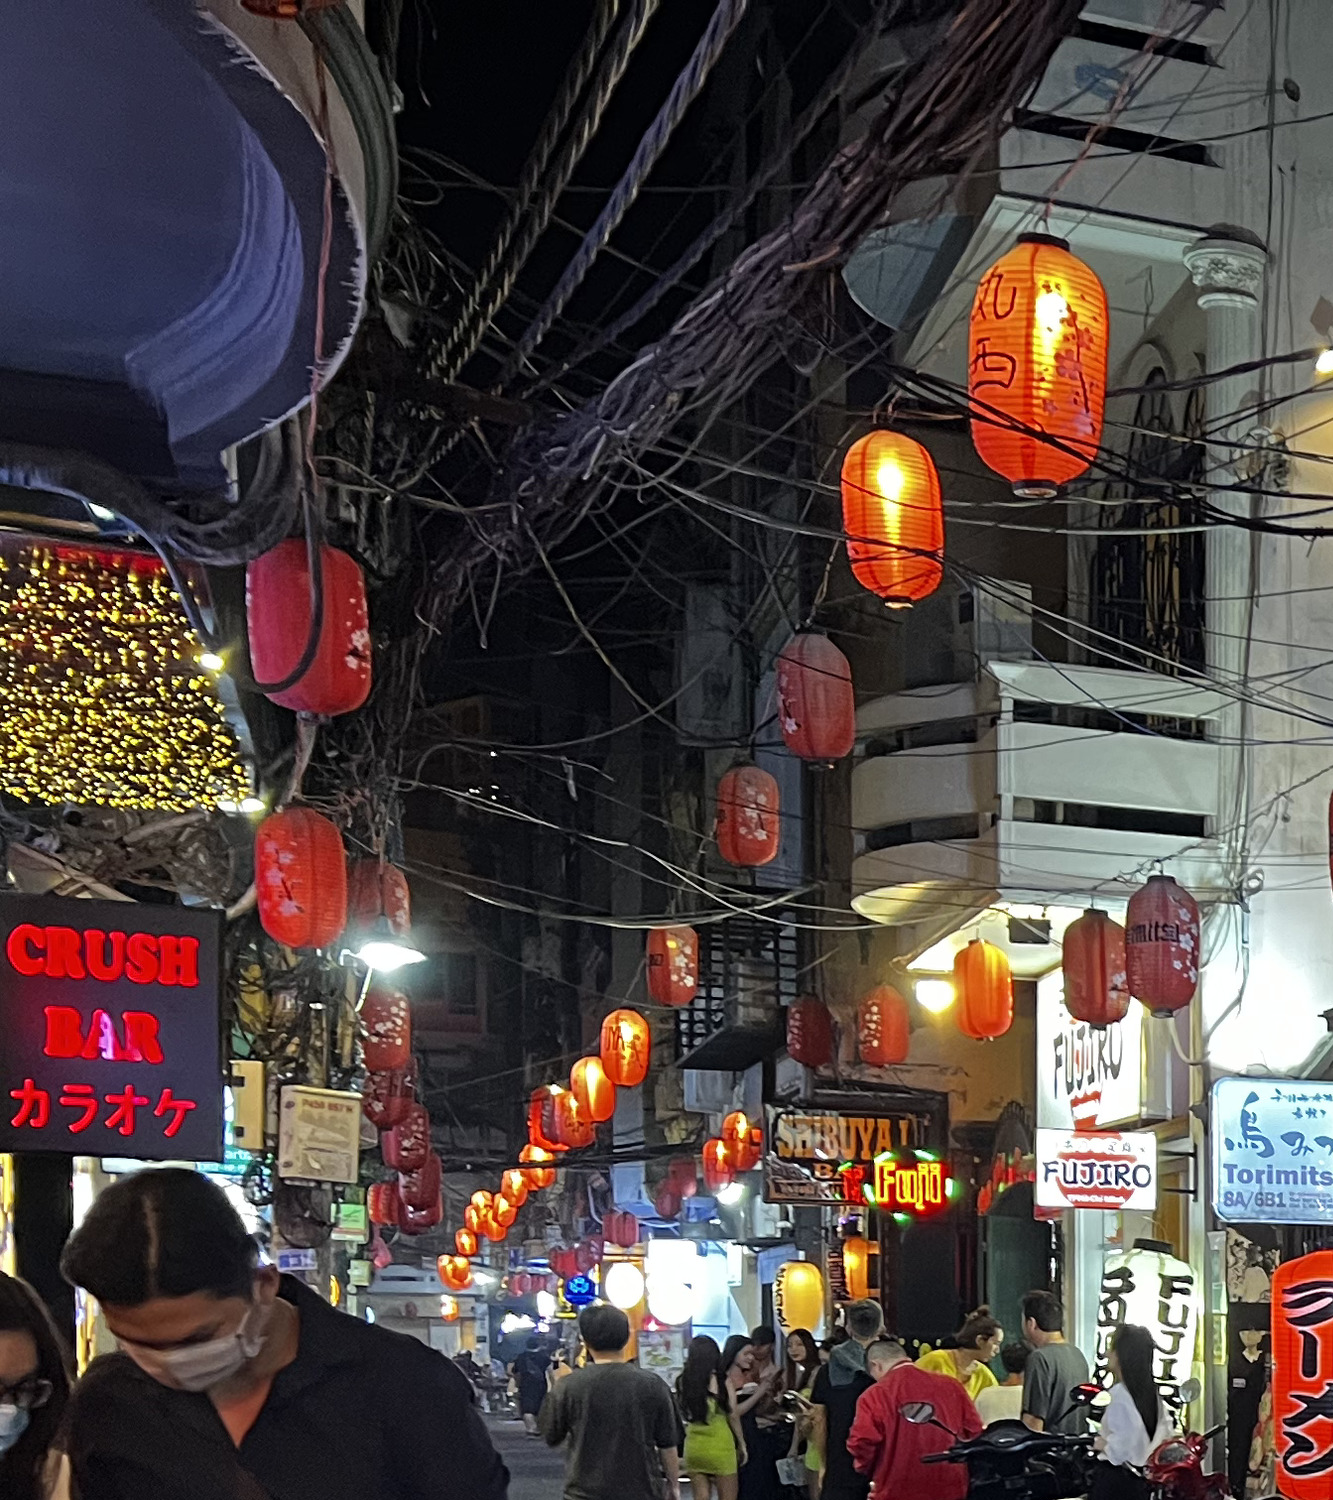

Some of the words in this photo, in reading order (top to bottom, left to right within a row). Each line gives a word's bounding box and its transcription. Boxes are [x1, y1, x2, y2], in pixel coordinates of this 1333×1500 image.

[7, 923, 199, 987] CRUSH
[44, 1005, 164, 1064] BAR
[10, 1078, 197, 1137] カラオケ
[777, 1113, 893, 1160] SHIBUYA
[813, 1162, 846, 1180] BA
[1042, 1160, 1152, 1189] FUJIRO
[1223, 1190, 1287, 1210] 8A/6B1
[1153, 1273, 1195, 1428] FUJIR
